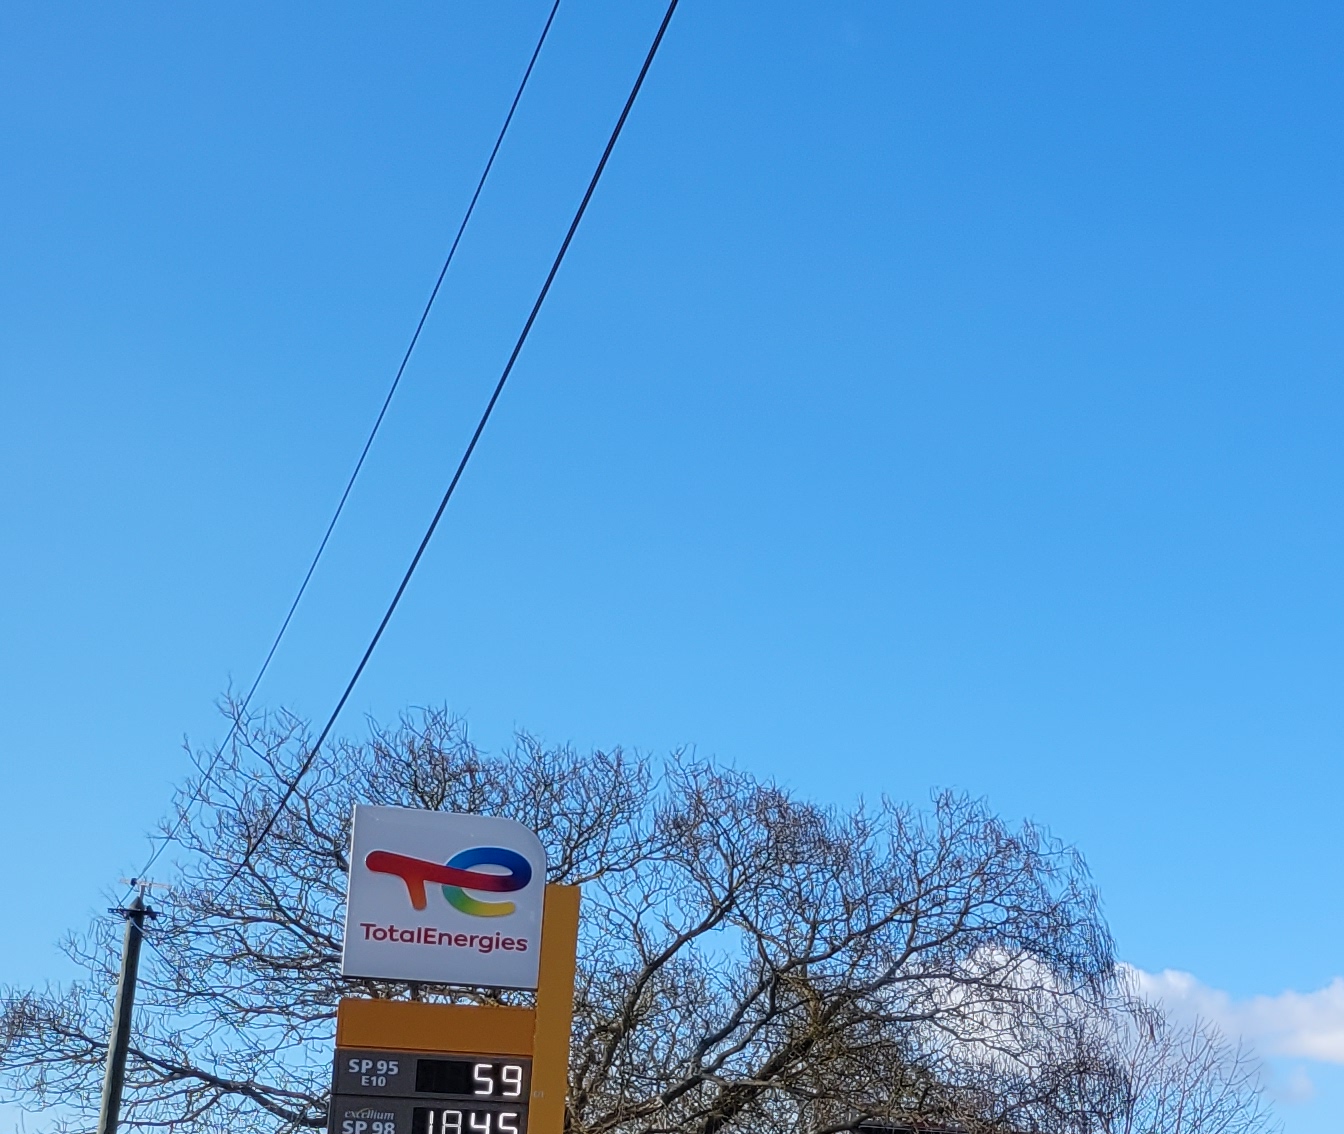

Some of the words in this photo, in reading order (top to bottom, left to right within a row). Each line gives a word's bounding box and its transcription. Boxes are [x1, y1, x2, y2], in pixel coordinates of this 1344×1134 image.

[360, 923, 528, 953] TotalEnergies
[349, 1059, 372, 1073] SP
[377, 1060, 398, 1075] 95
[361, 1076, 386, 1087] E10
[344, 1107, 394, 1120] excellium
[342, 1121, 367, 1134] SP
